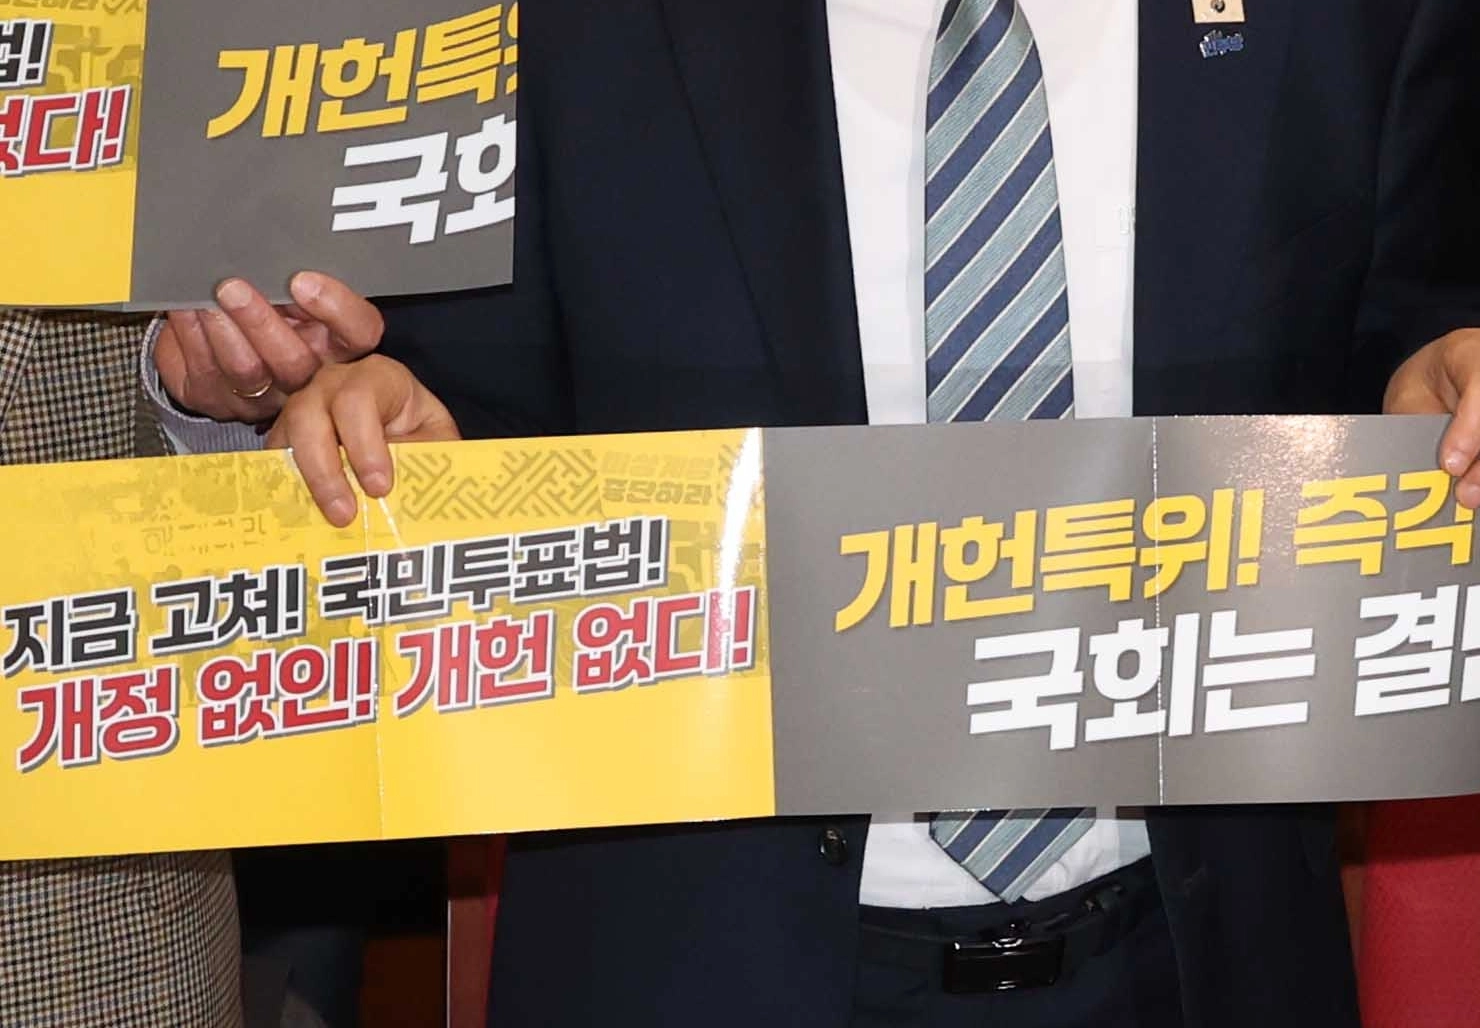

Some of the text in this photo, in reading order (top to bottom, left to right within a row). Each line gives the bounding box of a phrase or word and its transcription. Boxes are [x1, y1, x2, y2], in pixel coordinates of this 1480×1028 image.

[206, 1, 518, 139] 개헌특
[3, 584, 138, 674] 지금
[151, 562, 304, 659] 고쳐!
[319, 516, 669, 623] 국민투표법!
[835, 488, 1264, 632] 개헌특위!
[1293, 469, 1475, 576] 즉각
[15, 586, 755, 773] 개정 없인! 개헌 없다!
[966, 609, 1317, 752] 국회는
